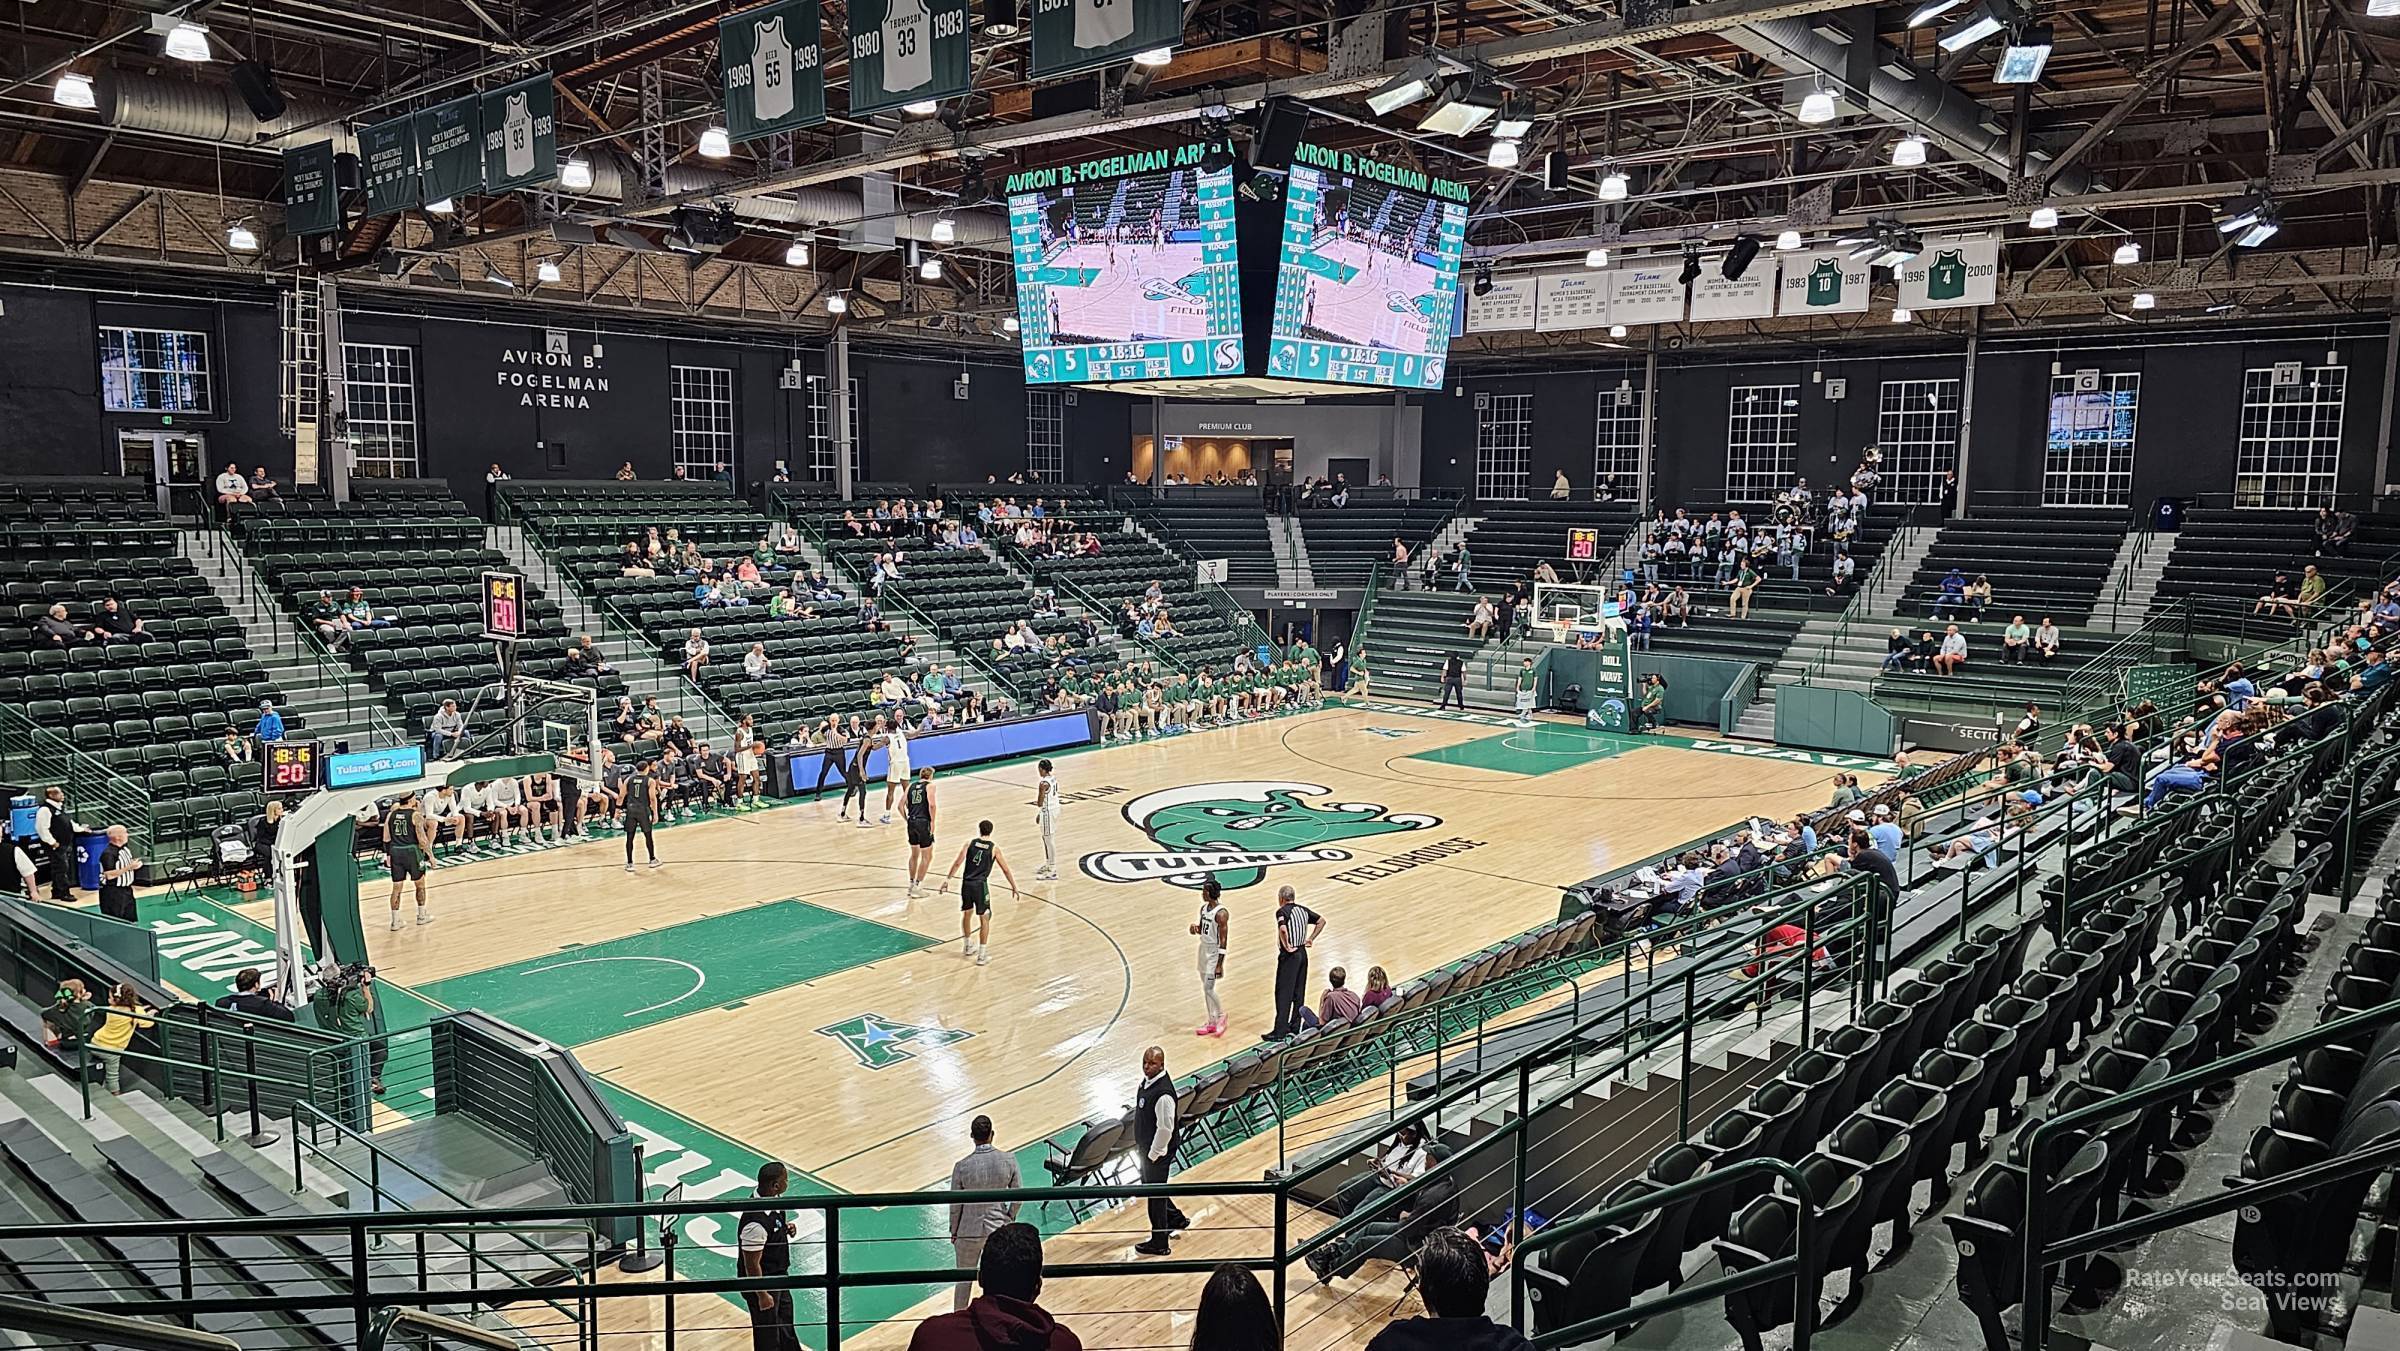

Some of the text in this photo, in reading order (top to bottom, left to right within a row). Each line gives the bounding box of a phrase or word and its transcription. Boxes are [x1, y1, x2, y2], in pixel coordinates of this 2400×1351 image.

[889, 13, 922, 30] THOMPSON
[933, 9, 963, 40] 1983
[852, 31, 880, 59] 1980
[897, 28, 915, 58] 33
[794, 43, 818, 71] 1993
[728, 63, 750, 89] 1989
[765, 61, 781, 88] 55
[534, 115, 552, 137] 1993
[486, 130, 504, 151] 1989
[512, 128, 524, 151] 93
[1005, 168, 1057, 193] AVRON
[1062, 166, 1076, 184] B.
[1080, 149, 1168, 182] FOGELMAN
[1293, 168, 1318, 182] TULANE
[1344, 155, 1356, 175] B.
[1359, 158, 1427, 192] FOGELMAN
[1431, 177, 1470, 203] ARENA
[1212, 189, 1218, 198] 2
[1301, 192, 1306, 200] 2
[1011, 196, 1037, 207] TULANE
[1023, 216, 1028, 224] 2
[1214, 211, 1220, 220] 0
[1215, 232, 1221, 241] 0
[1216, 253, 1222, 262] 0
[1633, 273, 1661, 282] TULANE
[1904, 270, 1925, 283] 1996
[1942, 270, 1951, 285] 4
[1967, 264, 1993, 277] 2000
[1561, 279, 1586, 289] TULANE
[1786, 278, 1806, 289] 1983
[1818, 278, 1831, 292] 10
[1845, 273, 1866, 285] 1987
[551, 339, 563, 351] A
[1110, 344, 1145, 360] 18:16
[502, 349, 602, 369] AVRON B.
[1065, 350, 1076, 370] 5
[1182, 343, 1195, 365] 0
[1310, 347, 1319, 367] 5
[1350, 348, 1378, 365] 18:16
[1120, 366, 1136, 377] 1ST
[1404, 356, 1413, 376] 0
[789, 375, 797, 386] B
[1354, 369, 1369, 380] 1ST
[2281, 370, 2293, 383] H
[497, 372, 609, 392] FOGELMAN
[2081, 377, 2093, 389] G
[958, 387, 966, 398] C
[1620, 393, 1627, 403] E
[1833, 386, 1840, 397] F
[520, 393, 590, 409] ARENA
[1068, 394, 1075, 404] D
[1478, 399, 1486, 408] D
[1573, 541, 1593, 558] 20
[494, 599, 514, 631] 20
[1602, 655, 1622, 667] ROLL
[1600, 671, 1624, 683] WAVE
[896, 739, 902, 750] 1
[275, 748, 311, 763] 18:16
[276, 765, 304, 784] 20
[911, 789, 923, 805] 15
[393, 819, 408, 836] 31
[973, 850, 983, 866] 4
[1120, 853, 1290, 871] TULANE
[1326, 837, 1488, 885] FIELDHOUSE
[1203, 923, 1210, 935] 12
[1961, 1243, 1974, 1255] 11
